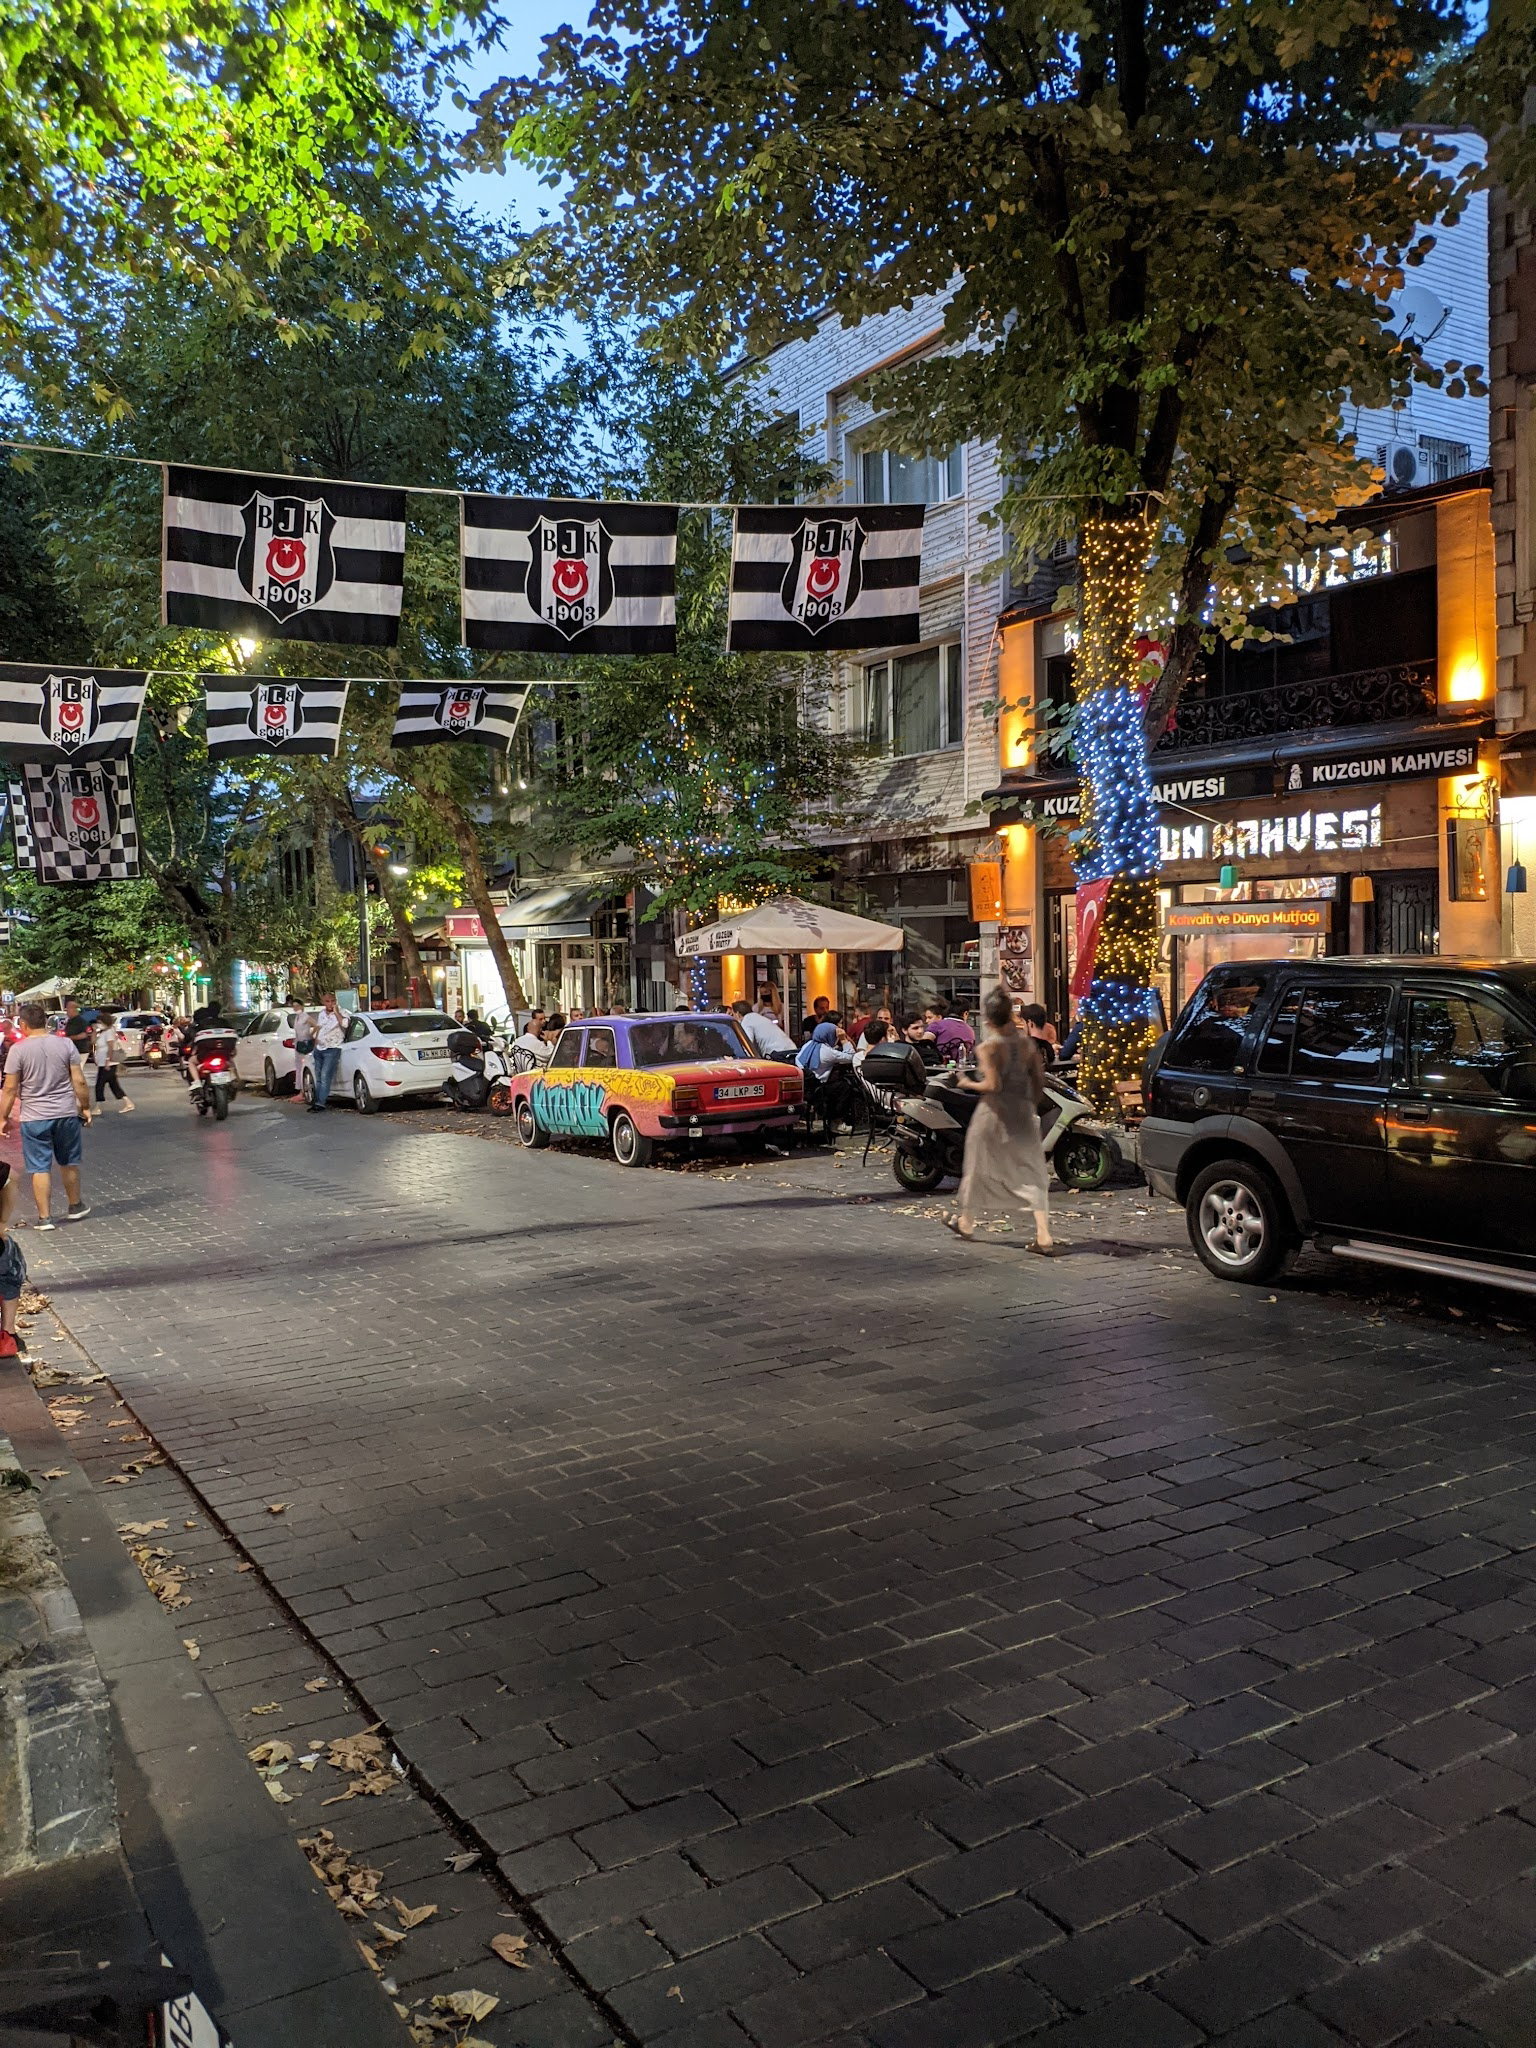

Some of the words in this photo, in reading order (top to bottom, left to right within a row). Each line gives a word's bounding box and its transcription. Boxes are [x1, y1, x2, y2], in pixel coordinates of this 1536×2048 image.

[257, 504, 320, 535] BJK
[543, 529, 599, 554] BJK
[803, 529, 854, 553] BJK
[257, 585, 313, 605] 1903
[546, 604, 596, 622] 1903
[797, 601, 842, 618] 1903
[1312, 758, 1387, 783] KUZGUN
[1043, 795, 1082, 817] KUZ
[1216, 915, 1230, 925] ve
[1232, 911, 1270, 927] Dünya
[1272, 909, 1321, 926] Mutfağı
[718, 1088, 729, 1098] 34
[733, 1087, 749, 1097] LKP
[753, 1085, 764, 1095] 95
